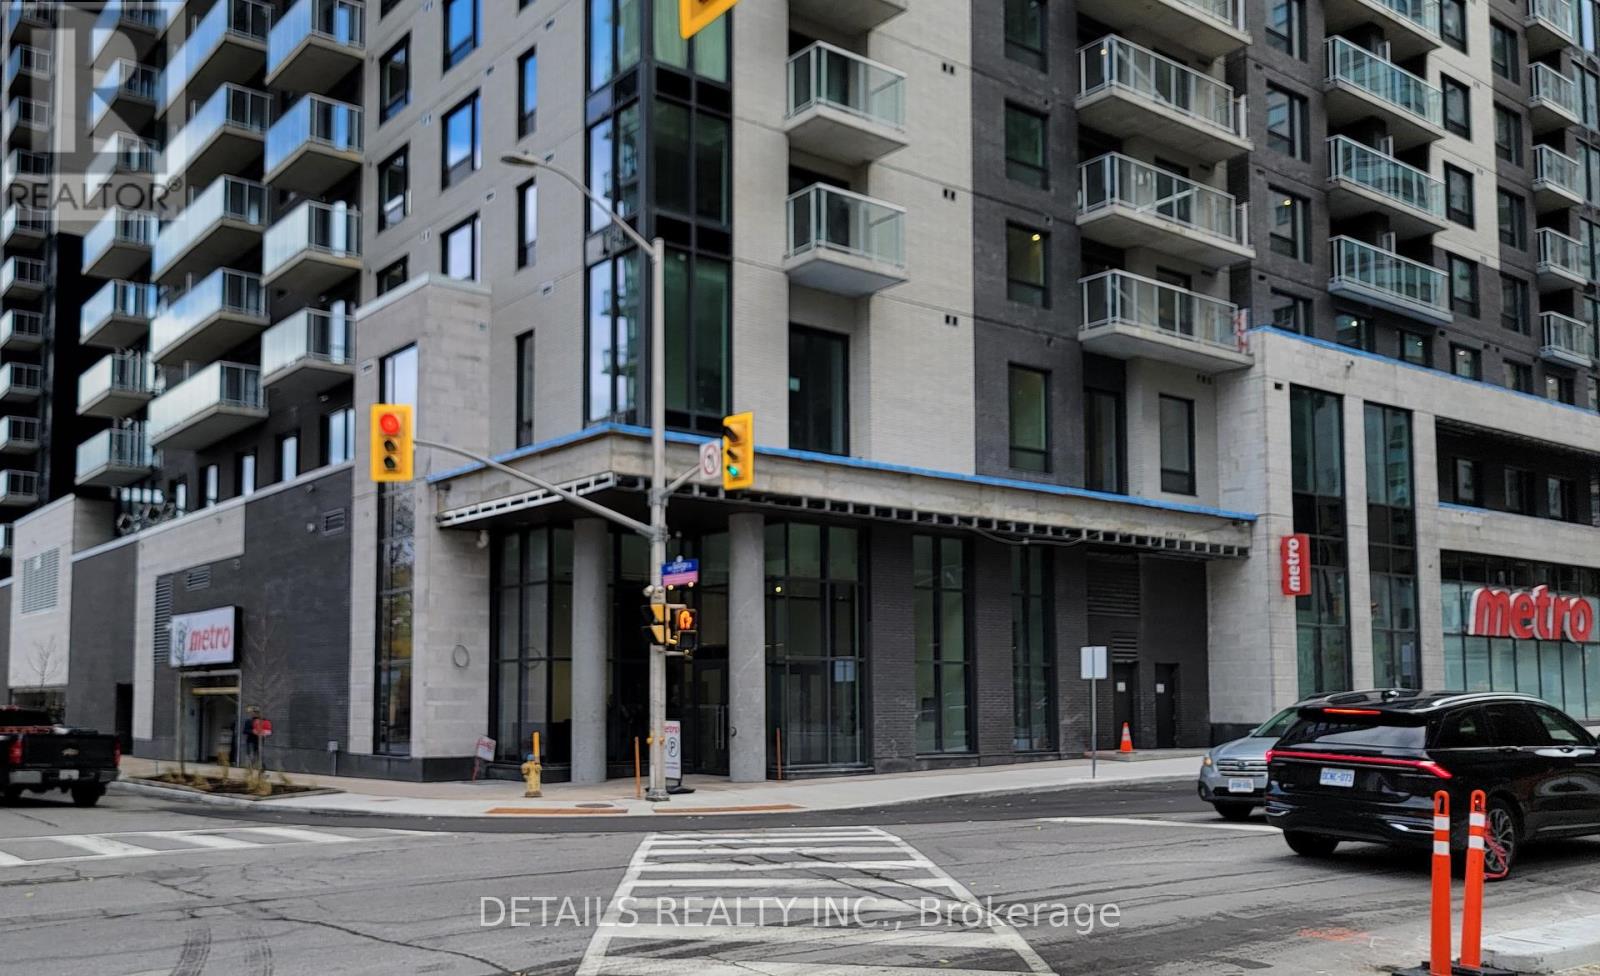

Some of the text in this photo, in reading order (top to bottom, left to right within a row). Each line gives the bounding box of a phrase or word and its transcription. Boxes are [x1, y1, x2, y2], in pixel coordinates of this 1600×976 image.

[1286, 537, 1301, 592] metro
[189, 625, 230, 651] metro
[1468, 584, 1593, 643] metro
